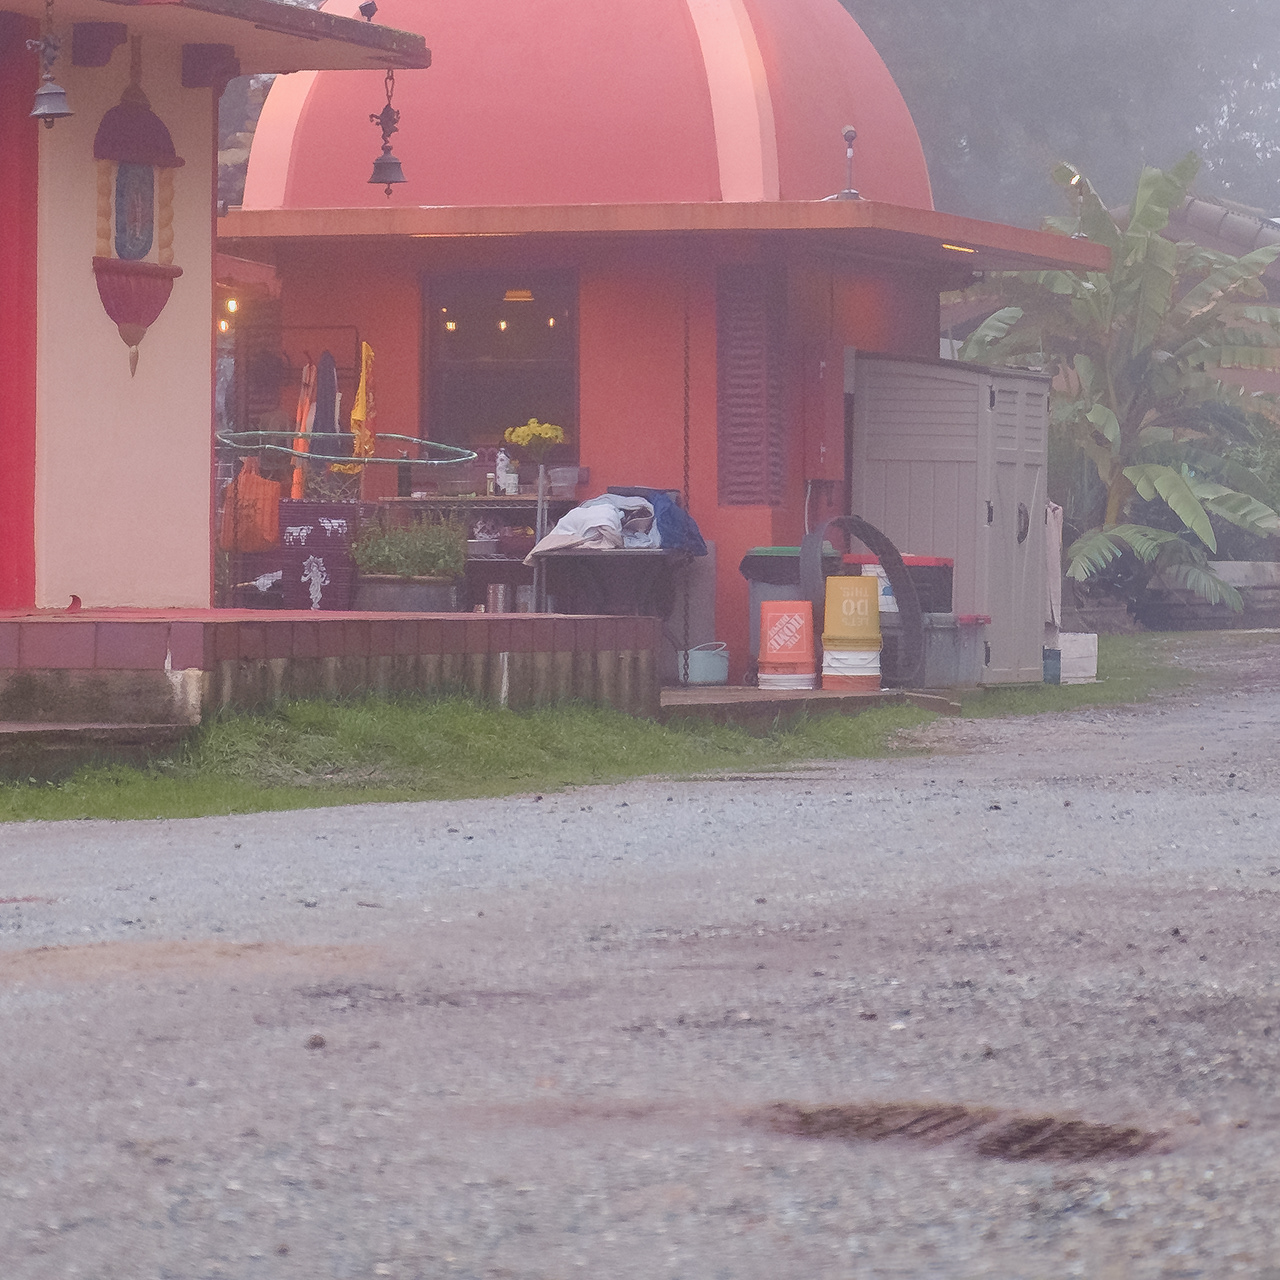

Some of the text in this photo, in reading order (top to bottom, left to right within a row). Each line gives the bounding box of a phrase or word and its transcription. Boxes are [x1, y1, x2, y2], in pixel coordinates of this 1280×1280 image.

[841, 598, 869, 616] DO
[841, 617, 869, 627] LET'S
[768, 613, 805, 653] HOME
[784, 633, 801, 649] THE
